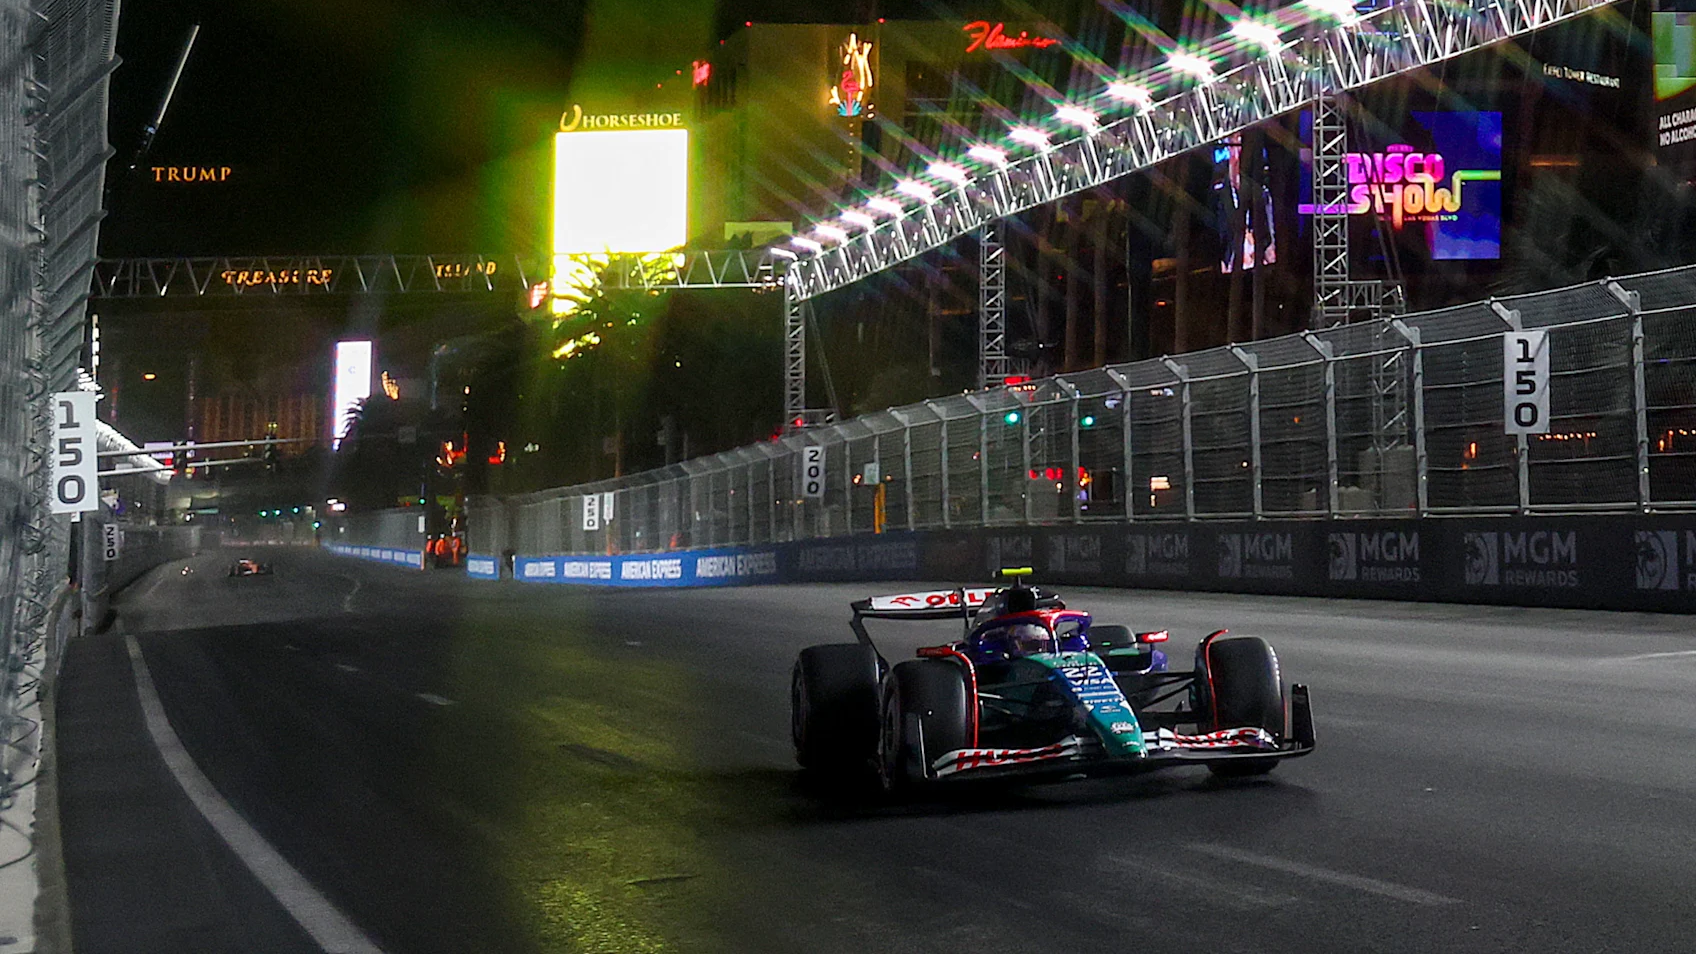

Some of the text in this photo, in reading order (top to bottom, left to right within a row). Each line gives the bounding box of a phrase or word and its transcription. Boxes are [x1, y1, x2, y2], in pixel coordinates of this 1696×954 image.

[582, 113, 683, 128] HORSESHOE
[1659, 115, 1672, 130] ALL
[1660, 131, 1670, 146] NO
[152, 167, 231, 181] TRUMP
[1347, 152, 1444, 184] DISCO
[1350, 178, 1461, 229] SHOW
[1514, 339, 1538, 427] 150
[57, 400, 85, 504] 150
[807, 450, 819, 494] 200
[585, 497, 596, 527] 250
[106, 527, 115, 558] 250
[1149, 535, 1188, 558] MGM
[1245, 534, 1293, 560] MGM
[1361, 532, 1420, 562] MGM
[1504, 531, 1577, 564] MGM
[696, 552, 776, 579] AMERICAN EXPRESS
[1361, 567, 1421, 582] REWARDS
[1505, 570, 1579, 587] REWARDS
[1061, 666, 1102, 678] 22
